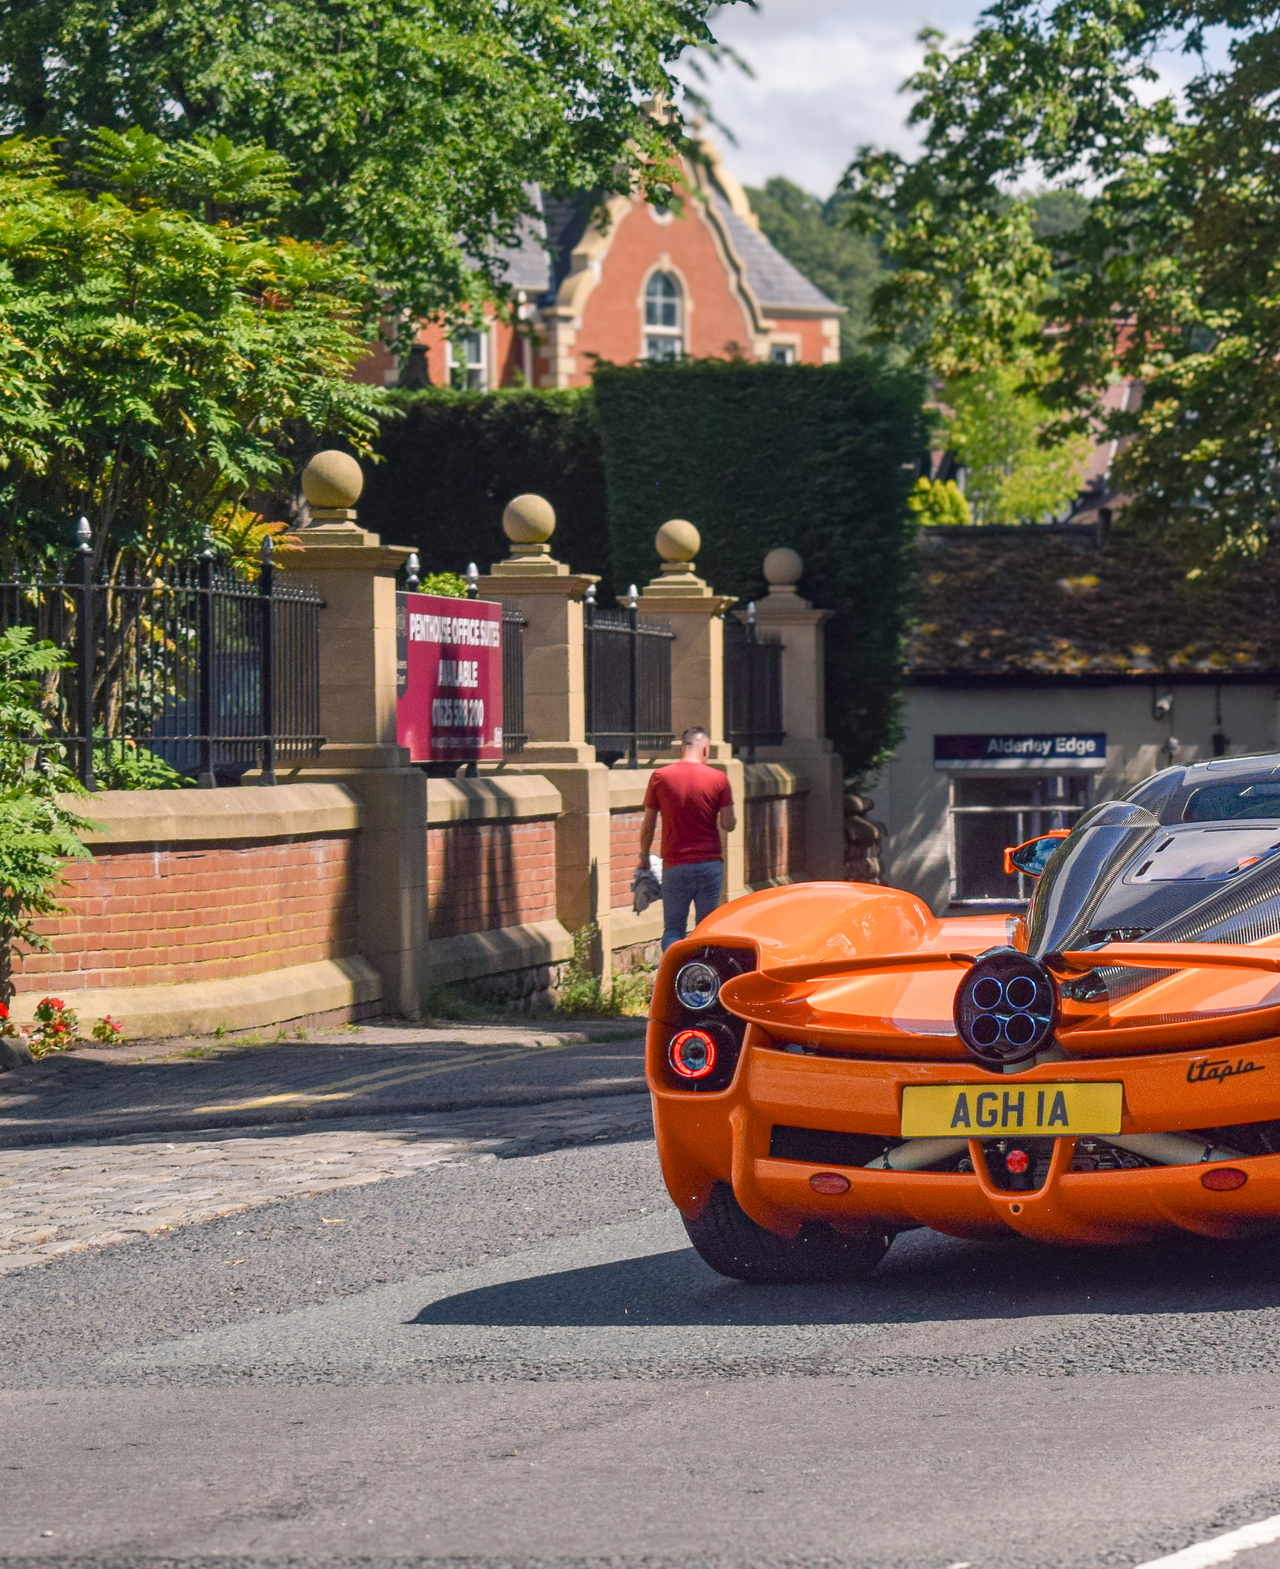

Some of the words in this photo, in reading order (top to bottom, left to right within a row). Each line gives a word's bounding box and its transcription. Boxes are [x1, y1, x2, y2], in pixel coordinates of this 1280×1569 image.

[409, 613, 451, 644] PENTHOUSE
[451, 617, 480, 646] OFFICE
[480, 620, 500, 647] SUITES
[437, 659, 478, 687] AVAILABLE
[987, 738, 1052, 755] Alderley
[1055, 737, 1096, 755] Edge
[950, 1091, 1025, 1128] AGH
